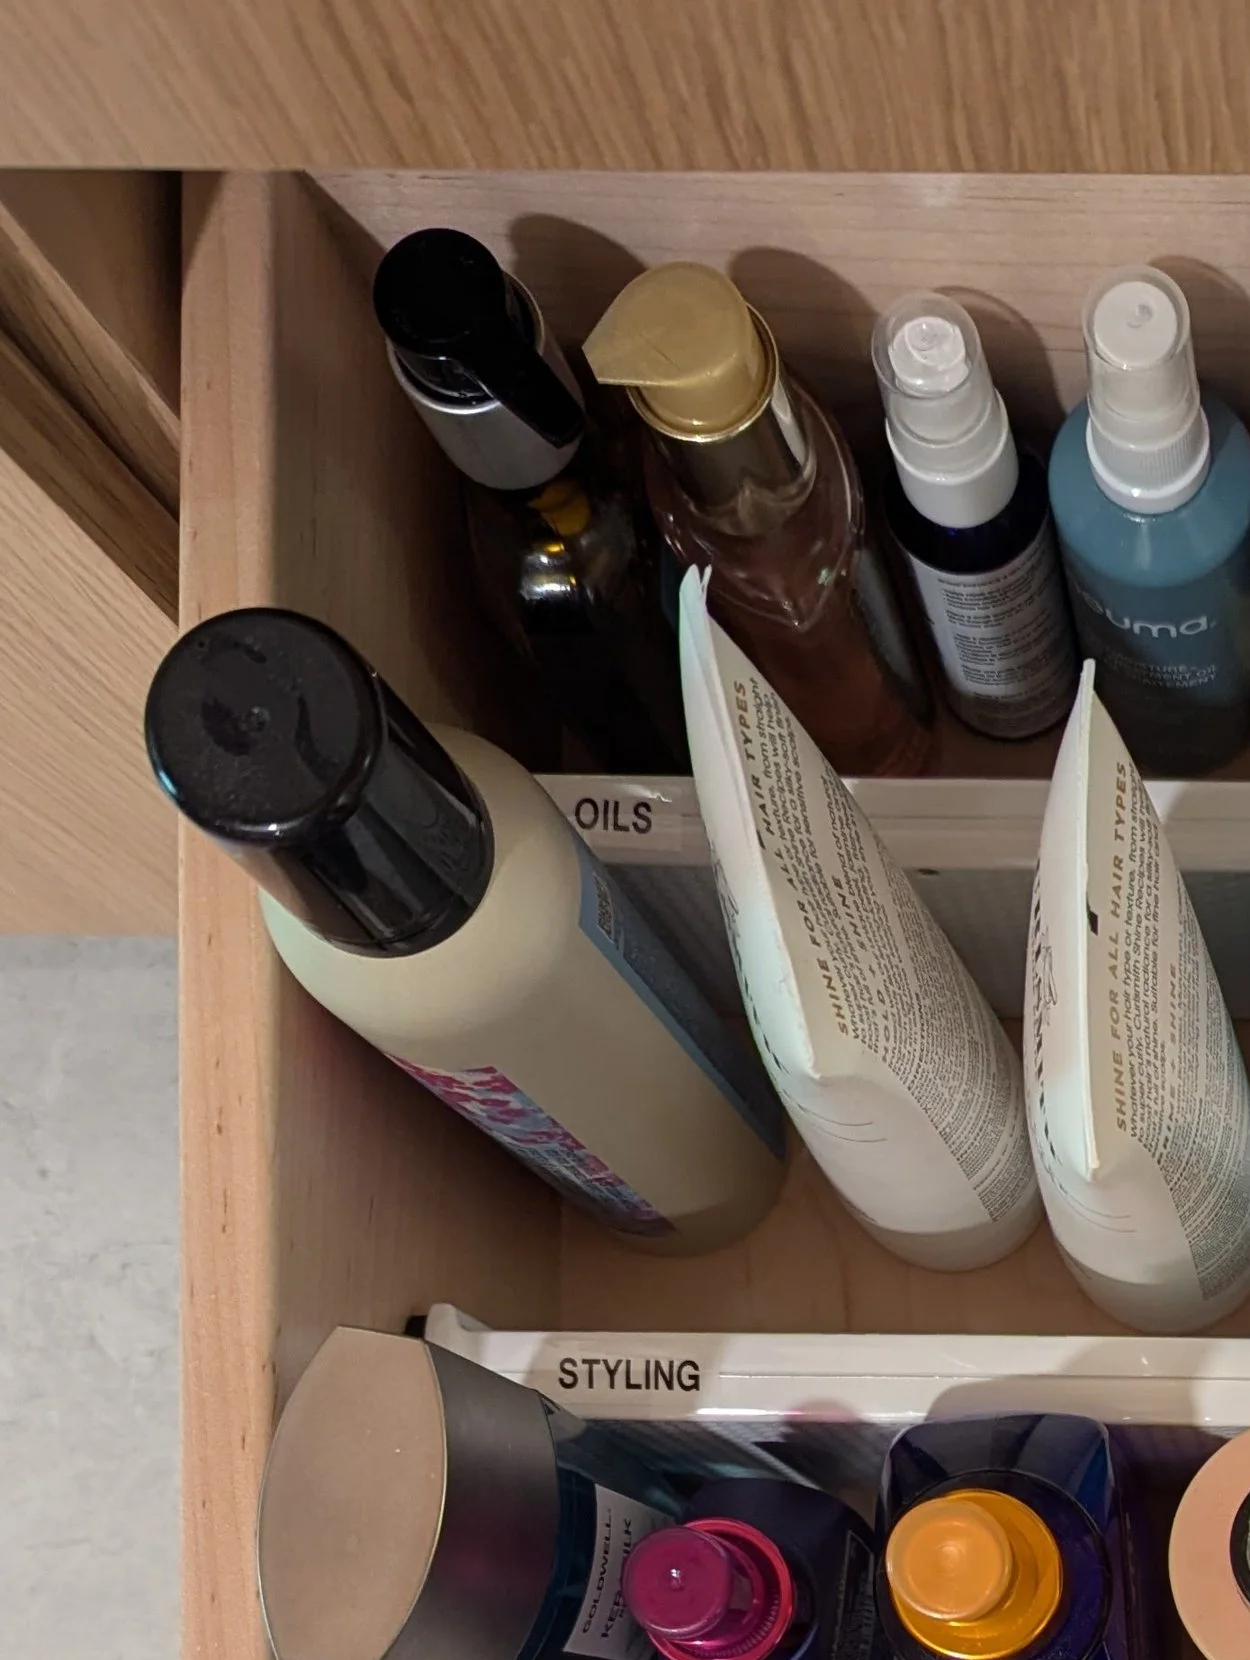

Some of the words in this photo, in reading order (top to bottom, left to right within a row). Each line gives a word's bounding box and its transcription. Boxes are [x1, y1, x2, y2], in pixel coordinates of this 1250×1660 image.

[732, 679, 756, 763] TYPES
[748, 675, 766, 740] straight
[759, 742, 772, 780] from
[768, 732, 779, 757] will
[575, 796, 654, 836] OILS
[749, 772, 774, 837] HAIR
[771, 760, 791, 824] Recipes
[793, 769, 811, 836] sensitive
[1113, 761, 1126, 841] TYPES
[806, 836, 818, 859] for
[1128, 826, 1138, 863] from
[1138, 818, 1146, 842] will
[773, 846, 798, 892] ALL
[1109, 854, 1123, 918] HAIR
[1134, 846, 1148, 910] Recipes
[1152, 859, 1160, 891] hair
[829, 873, 867, 953] SHINE
[1123, 868, 1136, 925] texture,
[1144, 900, 1152, 921] for
[1150, 892, 1159, 922] fine
[795, 898, 821, 949] FOR
[1124, 930, 1131, 947] or
[1132, 912, 1142, 955] Shine
[1150, 925, 1158, 947] for
[1106, 931, 1118, 979] ALL
[1121, 950, 1131, 986] type
[1140, 924, 1152, 997] radiance
[815, 955, 849, 1037] SHINE
[832, 962, 860, 1040] Whatever
[1108, 988, 1120, 1040] FOR
[1122, 992, 1131, 1019] hair
[1132, 959, 1141, 1030] Curlsmith
[1124, 1023, 1134, 1057] your
[1142, 1000, 1150, 1056] natural
[1112, 1050, 1126, 1131] SHINE
[1129, 1060, 1137, 1137] Whatever
[558, 1356, 700, 1392] STYLING
[601, 1517, 633, 1639] KERILK
